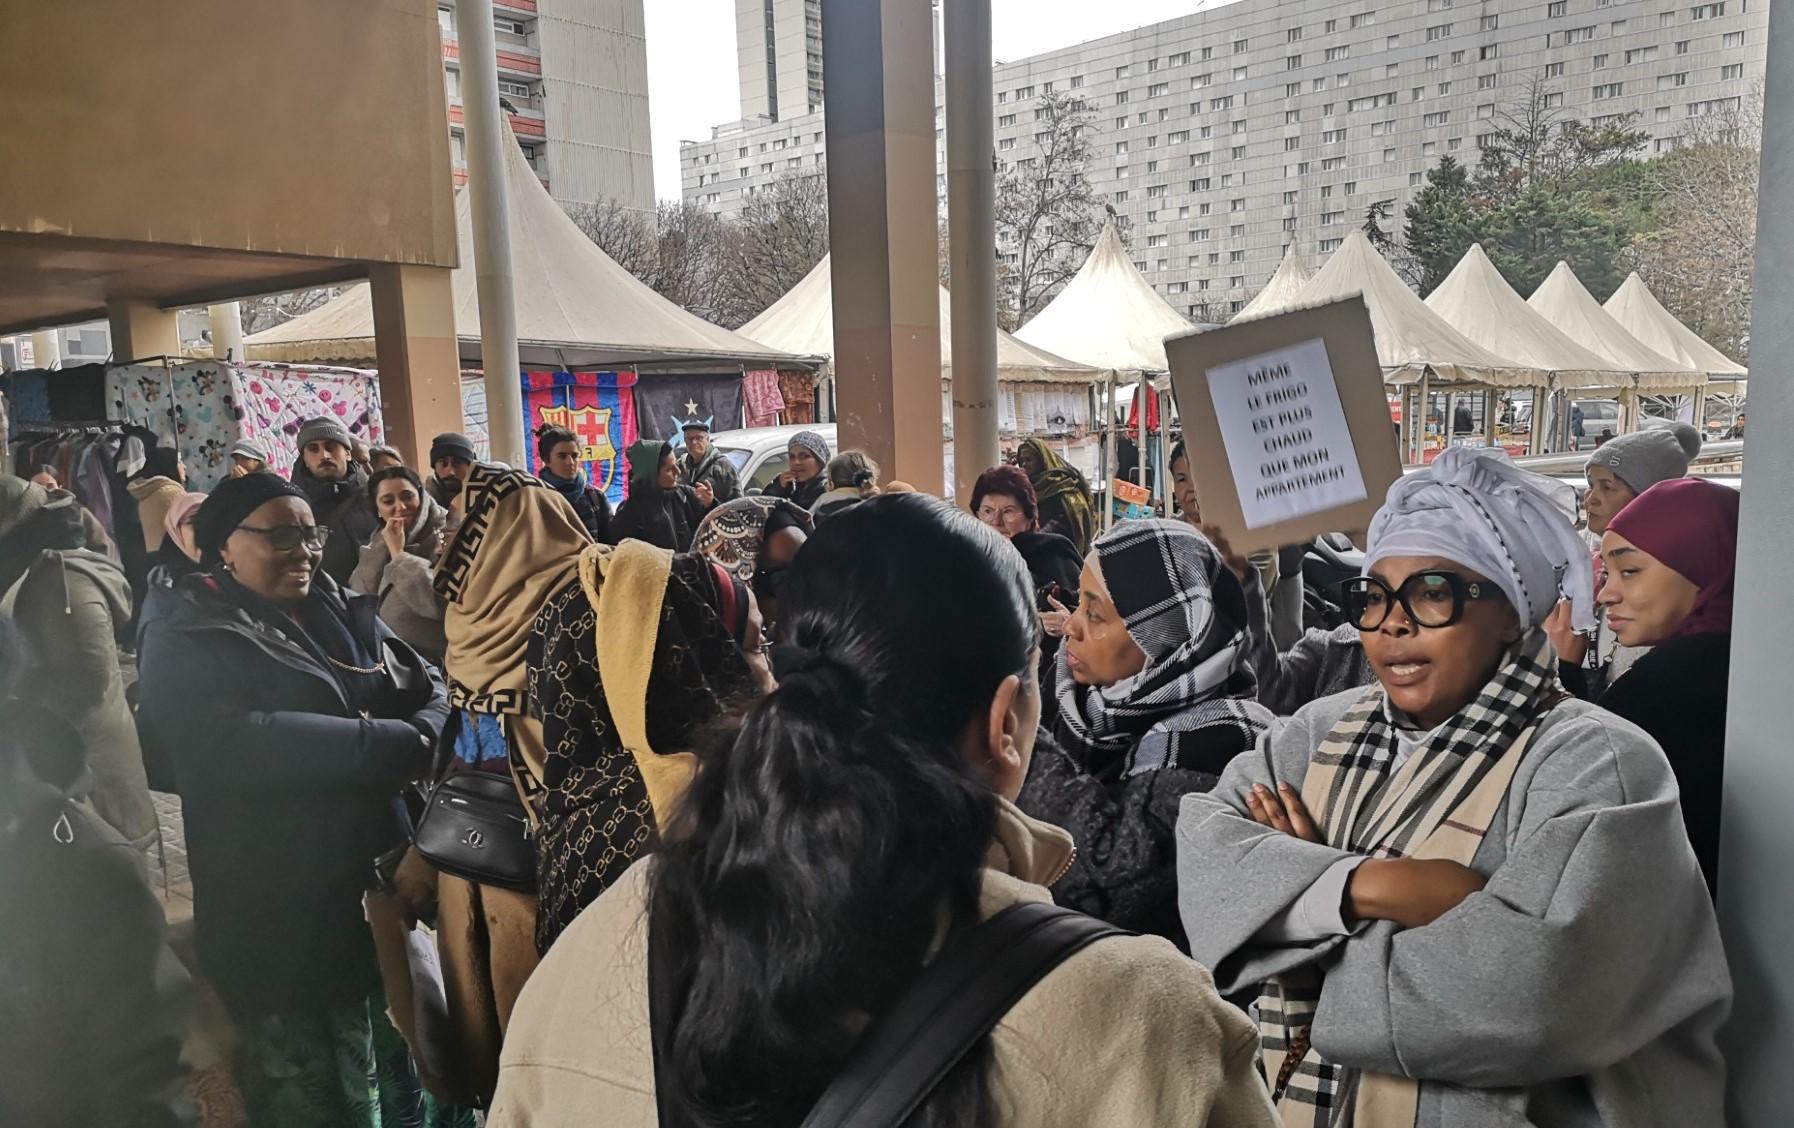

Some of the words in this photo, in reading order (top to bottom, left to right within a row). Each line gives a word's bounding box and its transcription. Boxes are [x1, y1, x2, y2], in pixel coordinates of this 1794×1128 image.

[1247, 395, 1263, 411] LE
[1265, 382, 1308, 406] FRIGO
[1252, 415, 1275, 434] EST
[1279, 406, 1313, 428] PLUS
[1263, 428, 1313, 454] CHAUD
[1260, 459, 1290, 479] QUE
[1292, 447, 1329, 470] MON
[1255, 464, 1345, 502] APPARTEMENT
